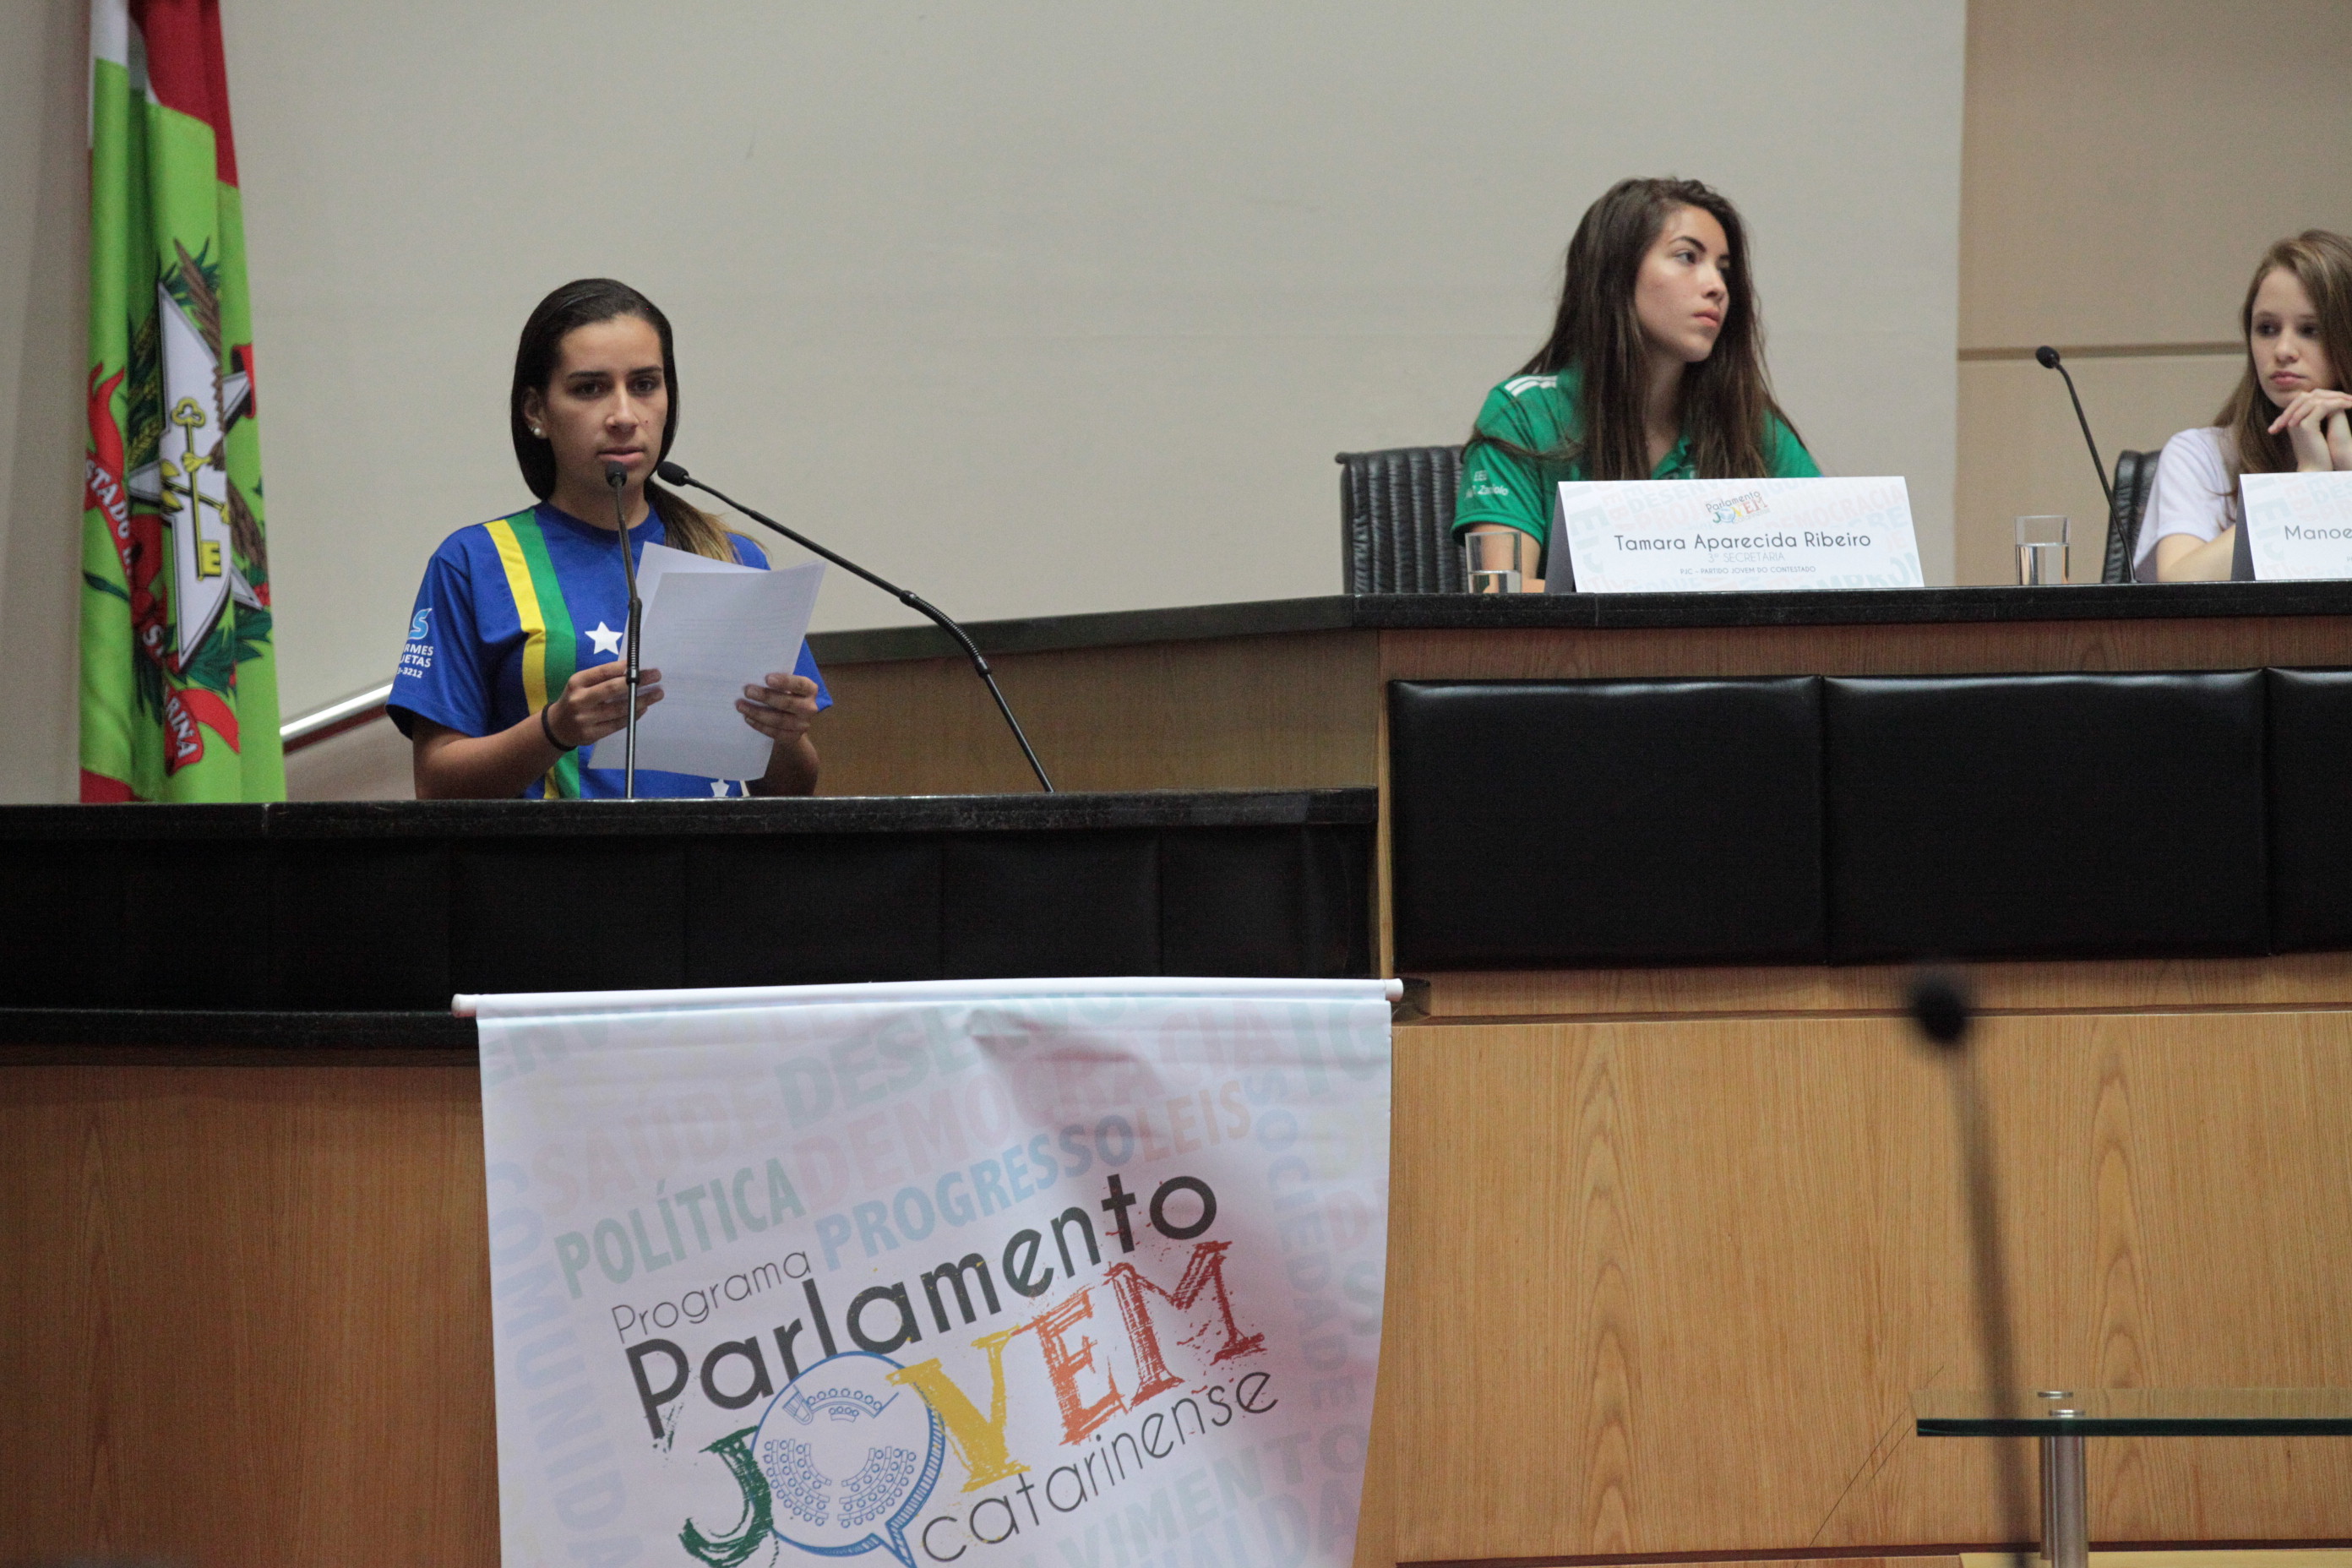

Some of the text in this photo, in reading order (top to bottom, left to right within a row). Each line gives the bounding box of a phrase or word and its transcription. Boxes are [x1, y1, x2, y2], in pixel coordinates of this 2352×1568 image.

[1614, 531, 1871, 552] Tamara Aparecida Ribeiro
[1705, 490, 1761, 513] Parlamento
[1712, 496, 1769, 524] JOVEM
[2284, 525, 2352, 540] Manoe
[1770, 565, 1816, 574] CONTESTADO
[814, 1115, 1135, 1272] PROGRESSO
[1136, 1079, 1252, 1163] LEIS
[553, 1157, 807, 1299] POLÍTICA
[611, 1250, 811, 1344] Programa
[625, 1173, 1217, 1439] Parlamento
[678, 1239, 1267, 1568] JOVEM
[922, 1371, 1279, 1563] catarinense
